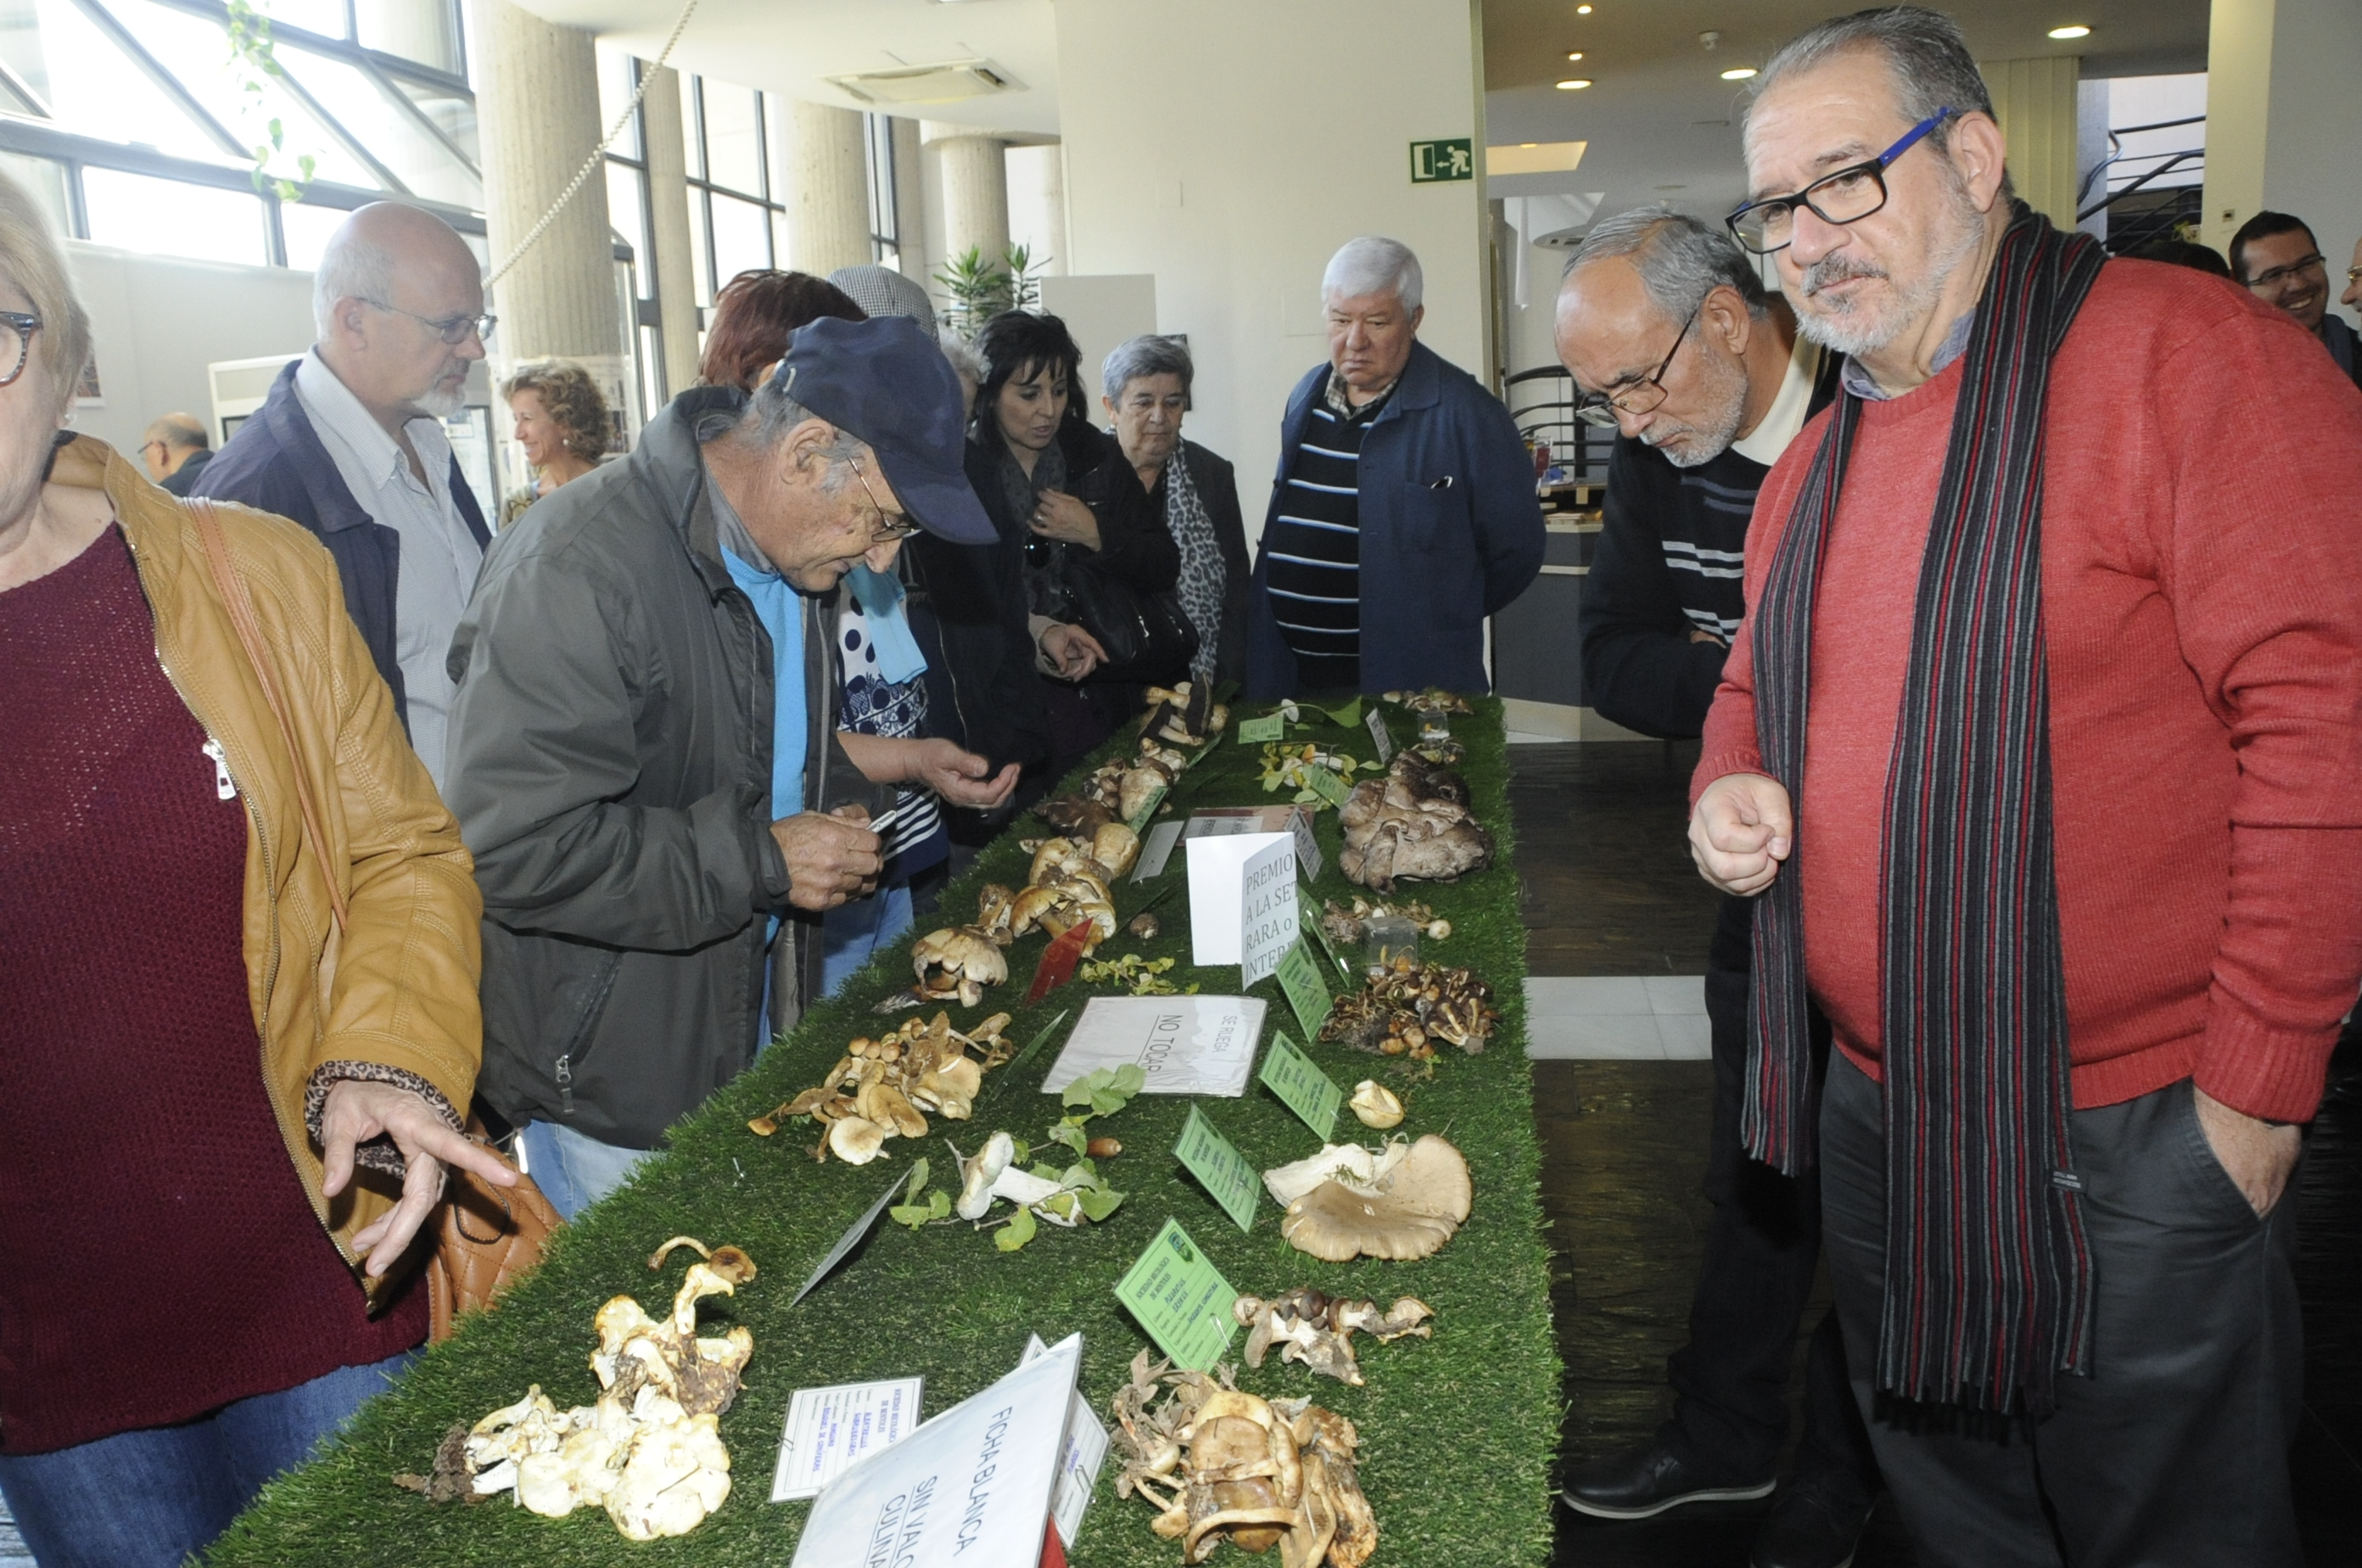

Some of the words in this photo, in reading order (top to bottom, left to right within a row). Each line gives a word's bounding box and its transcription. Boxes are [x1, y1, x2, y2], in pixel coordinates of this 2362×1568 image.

[1246, 854, 1293, 896] PREMIO
[1245, 905, 1253, 926] A
[1256, 893, 1271, 918] LA
[1246, 919, 1280, 954] RARA
[1158, 1015, 1184, 1032] NO
[1221, 1015, 1238, 1026] SE
[1212, 1027, 1234, 1053] RUEGA
[977, 1406, 1013, 1469] FICHA
[910, 1476, 938, 1513] SIN
[953, 1464, 996, 1557] BLANCA
